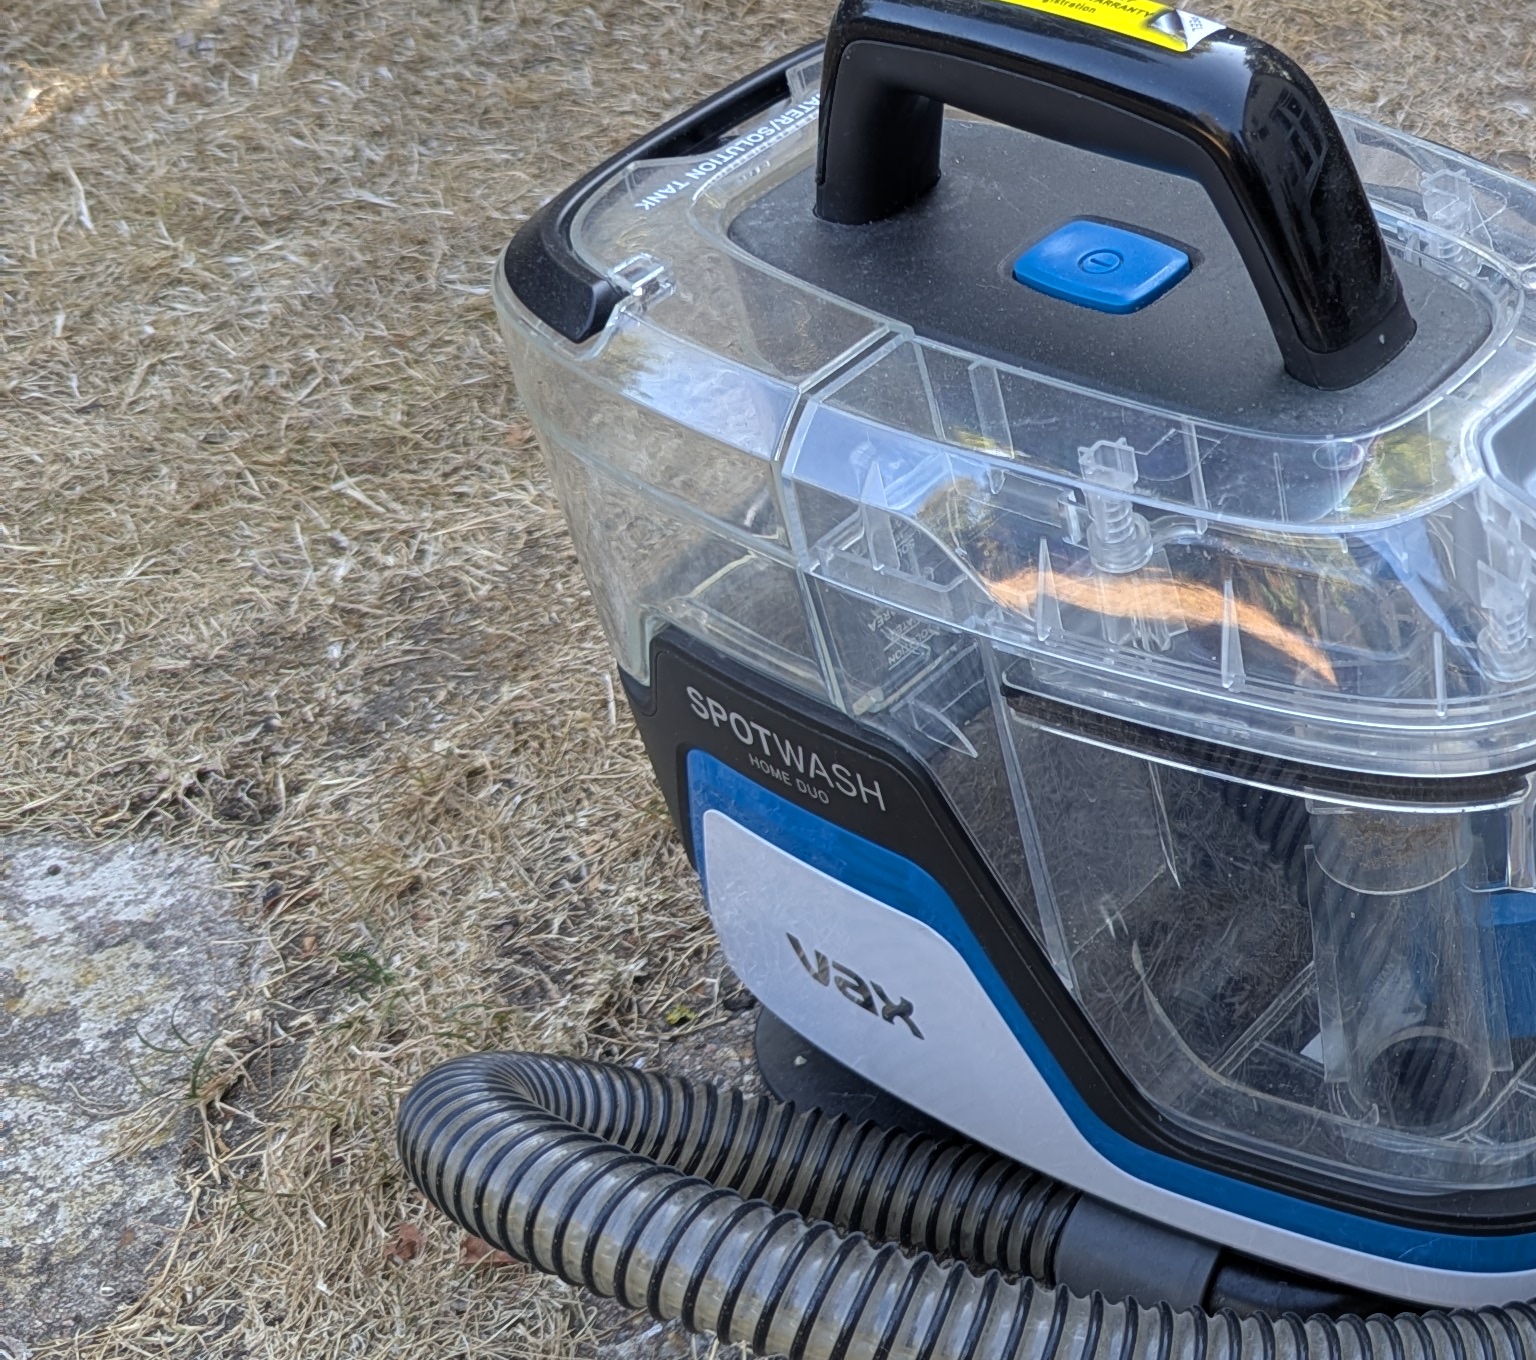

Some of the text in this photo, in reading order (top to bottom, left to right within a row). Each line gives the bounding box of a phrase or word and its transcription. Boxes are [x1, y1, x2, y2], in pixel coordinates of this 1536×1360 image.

[634, 94, 820, 211] ATER/SOLUTION TANK
[686, 686, 887, 811] SPOTWASH
[748, 753, 829, 804] HOME DUO
